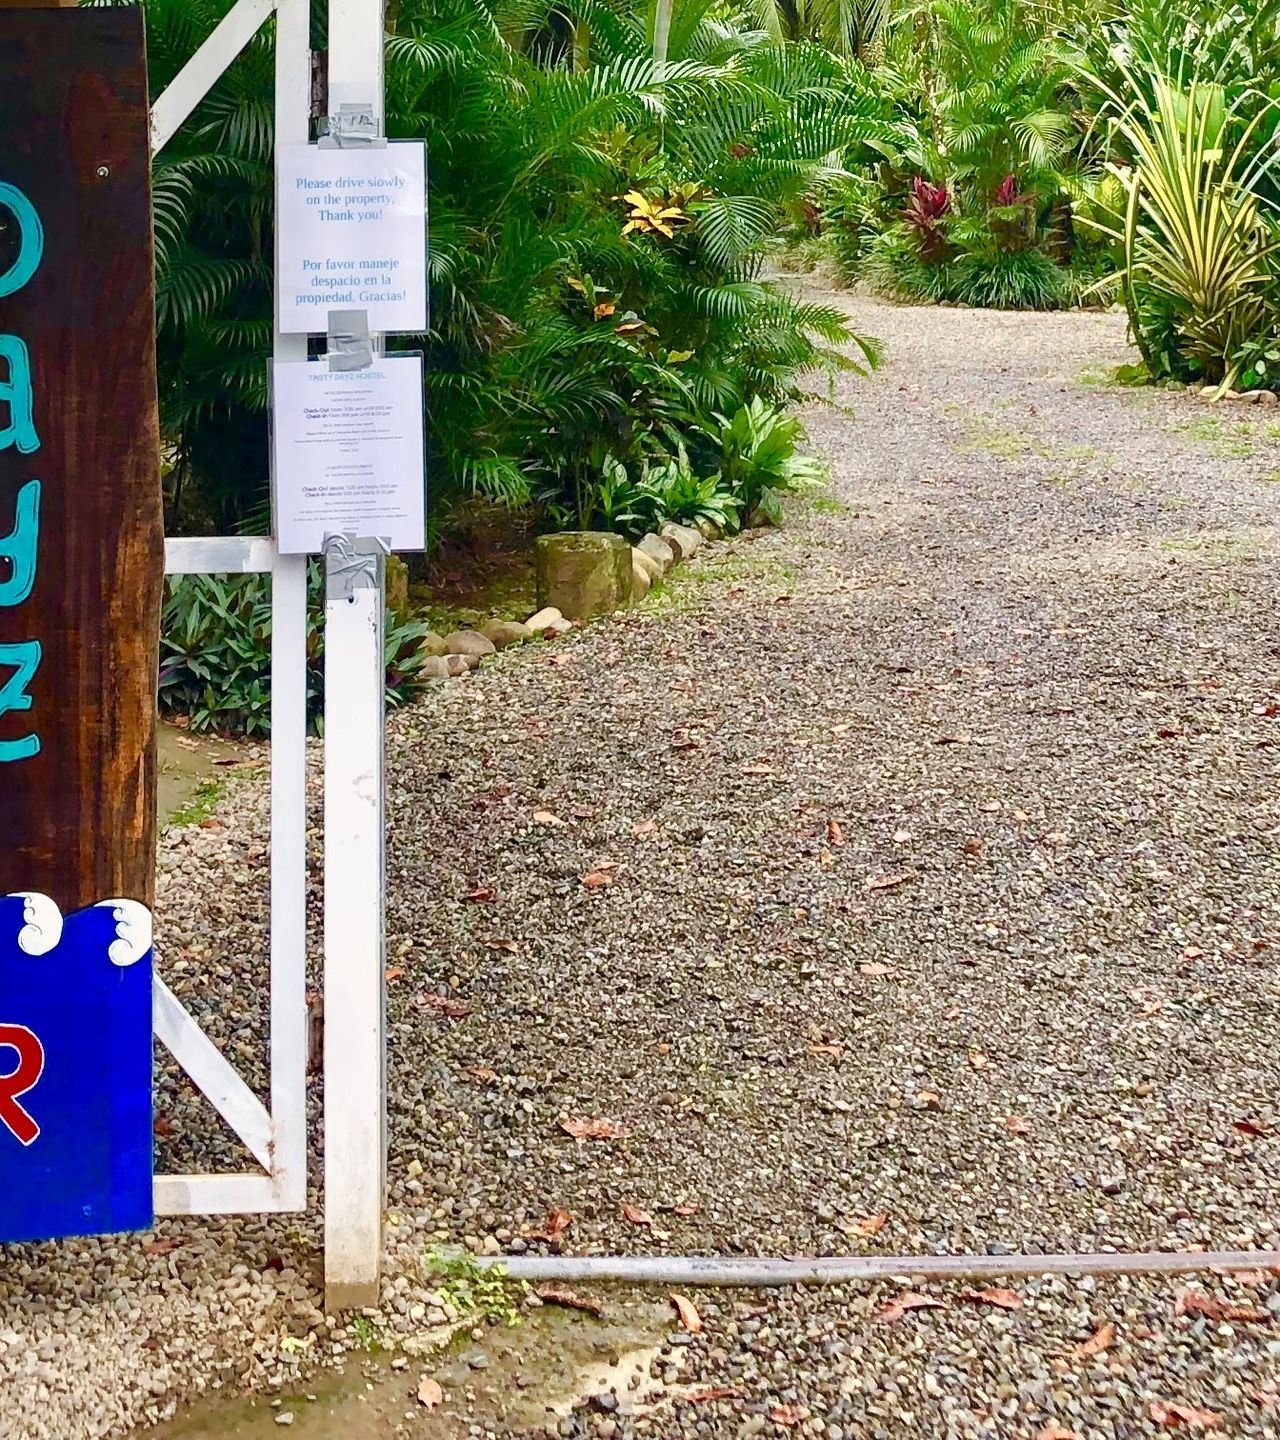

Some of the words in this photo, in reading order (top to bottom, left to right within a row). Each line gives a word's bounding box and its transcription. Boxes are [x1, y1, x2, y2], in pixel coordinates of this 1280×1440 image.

[296, 177, 332, 189] Please
[335, 176, 365, 189] drive
[367, 175, 406, 190] slowly
[306, 195, 320, 205] on
[324, 193, 341, 205] the
[318, 209, 354, 221] Thank
[357, 209, 383, 224] you!
[303, 259, 322, 271] Por
[325, 258, 356, 271] favor
[359, 257, 400, 272] maneje
[311, 274, 360, 289] despacio
[364, 275, 378, 286] en
[381, 274, 391, 285] la
[359, 290, 407, 302] Gracias!
